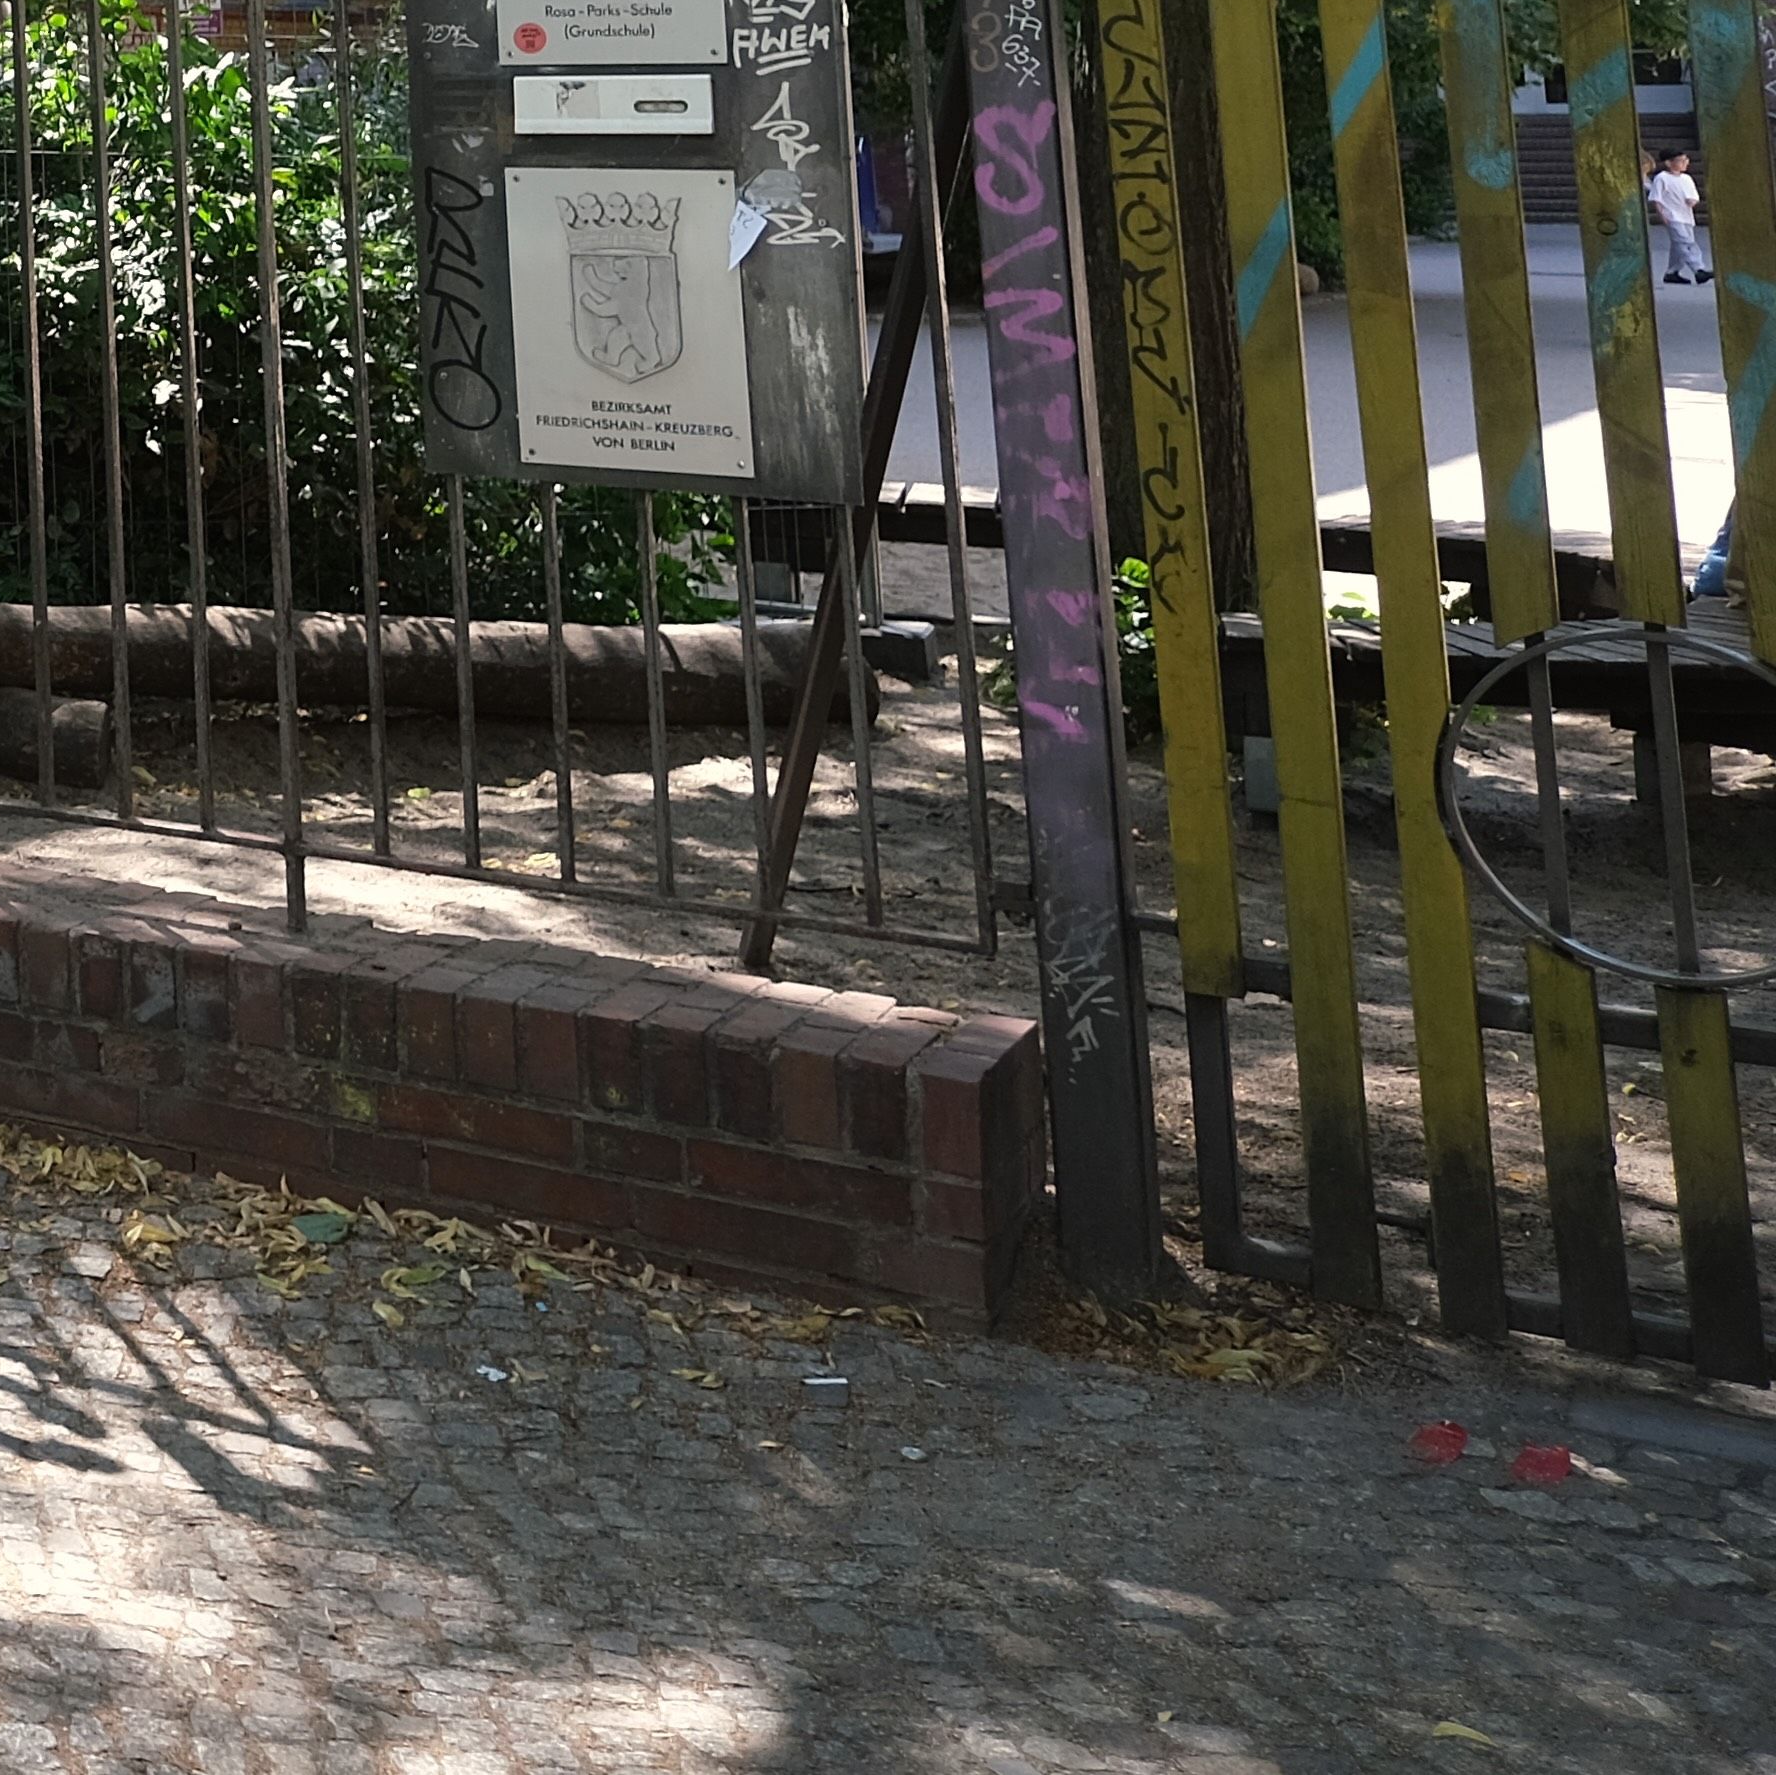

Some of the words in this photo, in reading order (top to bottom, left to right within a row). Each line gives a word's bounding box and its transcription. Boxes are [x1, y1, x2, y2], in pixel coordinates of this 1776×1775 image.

[564, 23, 655, 40] (Grundschule)
[591, 400, 672, 415] BEZIRKSAMT
[593, 436, 624, 449] VON
[630, 437, 676, 451] BERLIN
